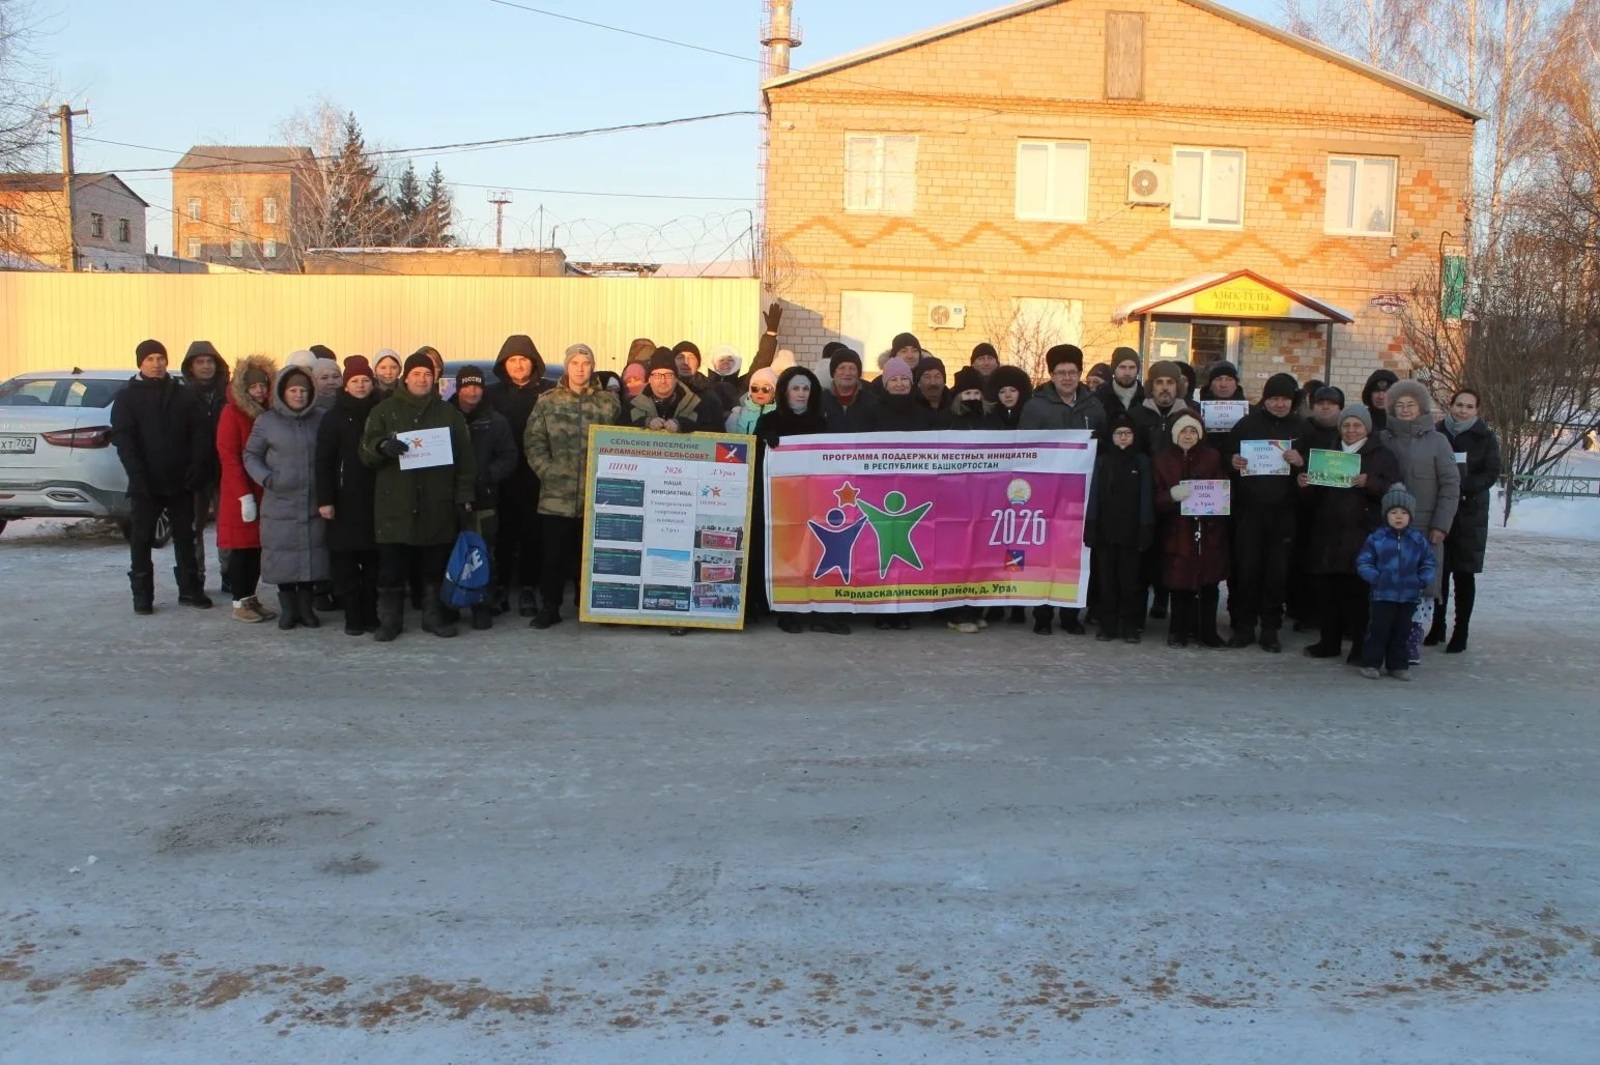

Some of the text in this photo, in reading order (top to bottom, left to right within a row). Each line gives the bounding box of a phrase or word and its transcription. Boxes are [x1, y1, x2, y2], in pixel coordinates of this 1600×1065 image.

[1215, 301, 1270, 312] ПРОДУКТЫ
[16, 438, 32, 448] 702
[610, 438, 700, 450] СЕЛЬСКОЕ ПОСЕЛЕНИЕ
[663, 451, 710, 460] СЕЛЬСОВЕТ
[822, 452, 1038, 461] ПРОГРАММА ПОДДЕРЖКИ МЕСТНЫХ ИНИЦИАТИВ
[872, 462, 930, 470] РЕСПУБЛИКЕ
[932, 462, 999, 470] БАШКОРТОСТАН
[989, 508, 1047, 546] 2026
[835, 586, 939, 599] Кармаскалинский
[992, 583, 1017, 594] Урал
